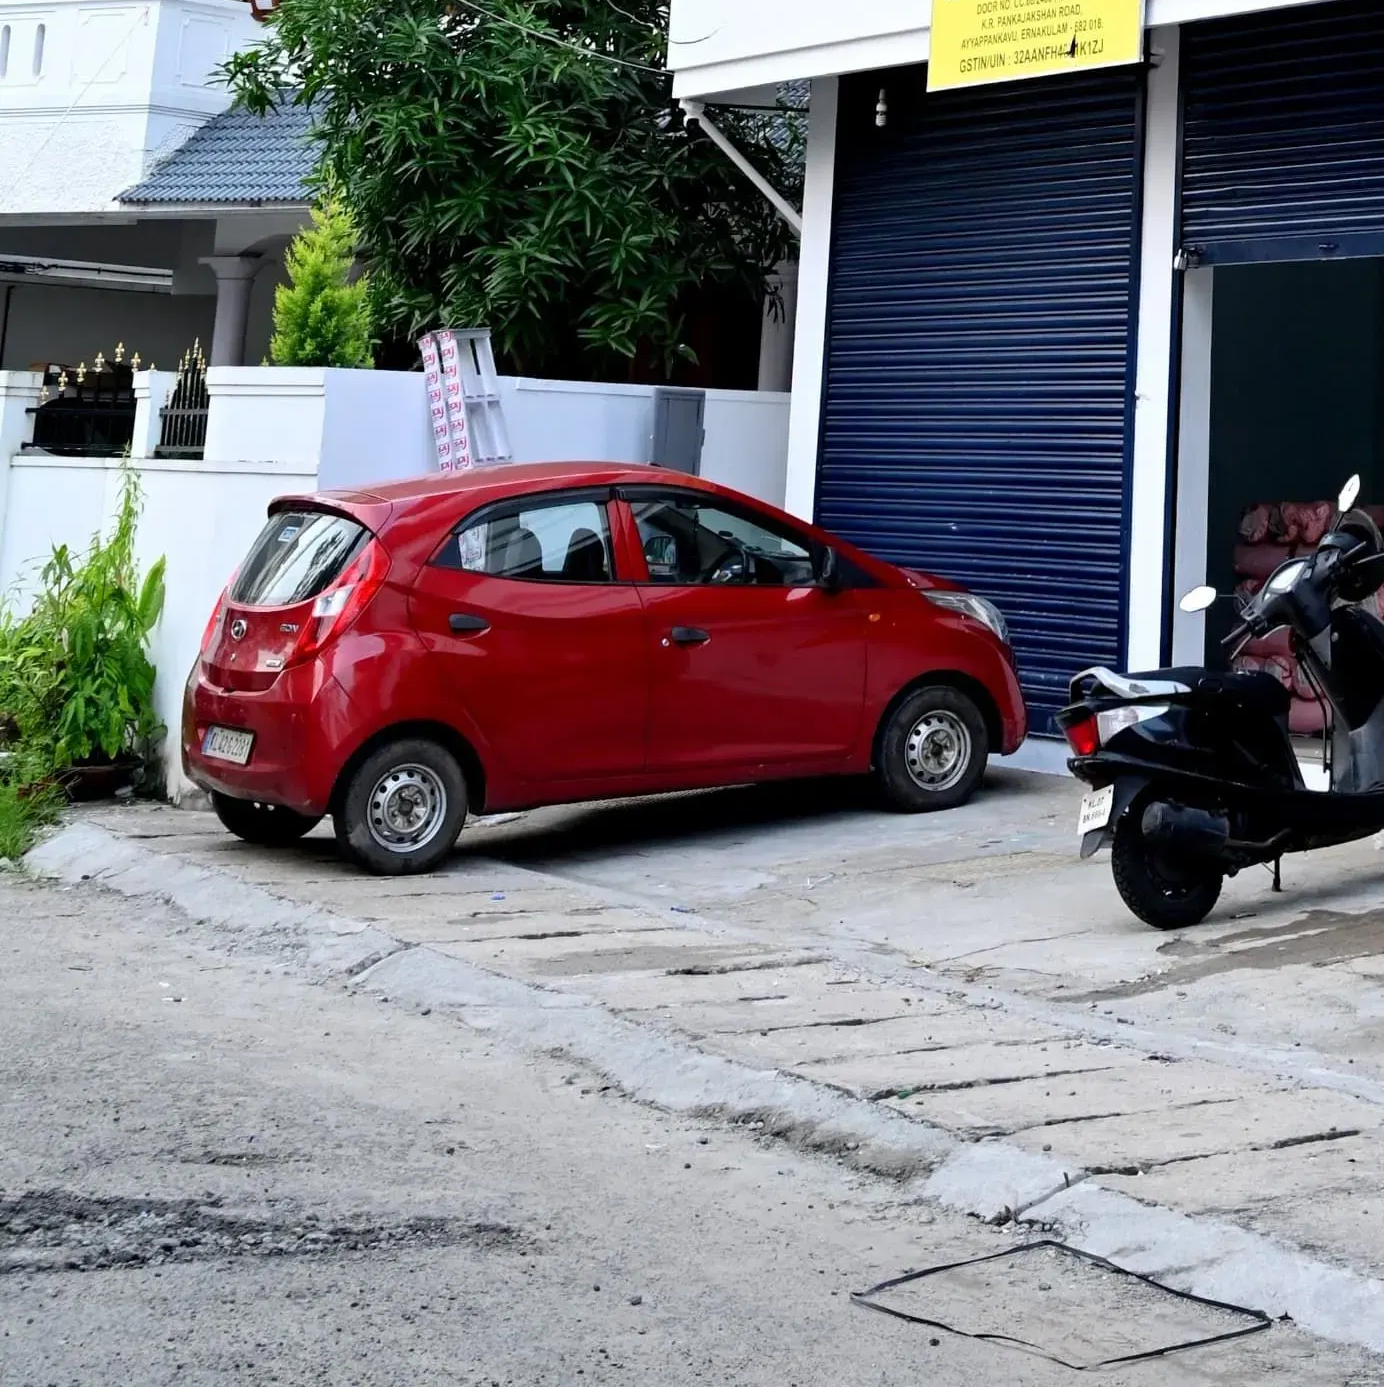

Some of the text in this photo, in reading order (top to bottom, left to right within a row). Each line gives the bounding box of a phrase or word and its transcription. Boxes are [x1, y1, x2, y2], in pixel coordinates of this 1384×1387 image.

[976, 1, 998, 15] DOOR
[997, 8, 1057, 28] PANKAJAKSHAN
[1021, 22, 1068, 40] ERNAKULAM
[959, 53, 1006, 73] GSTIN/UIN
